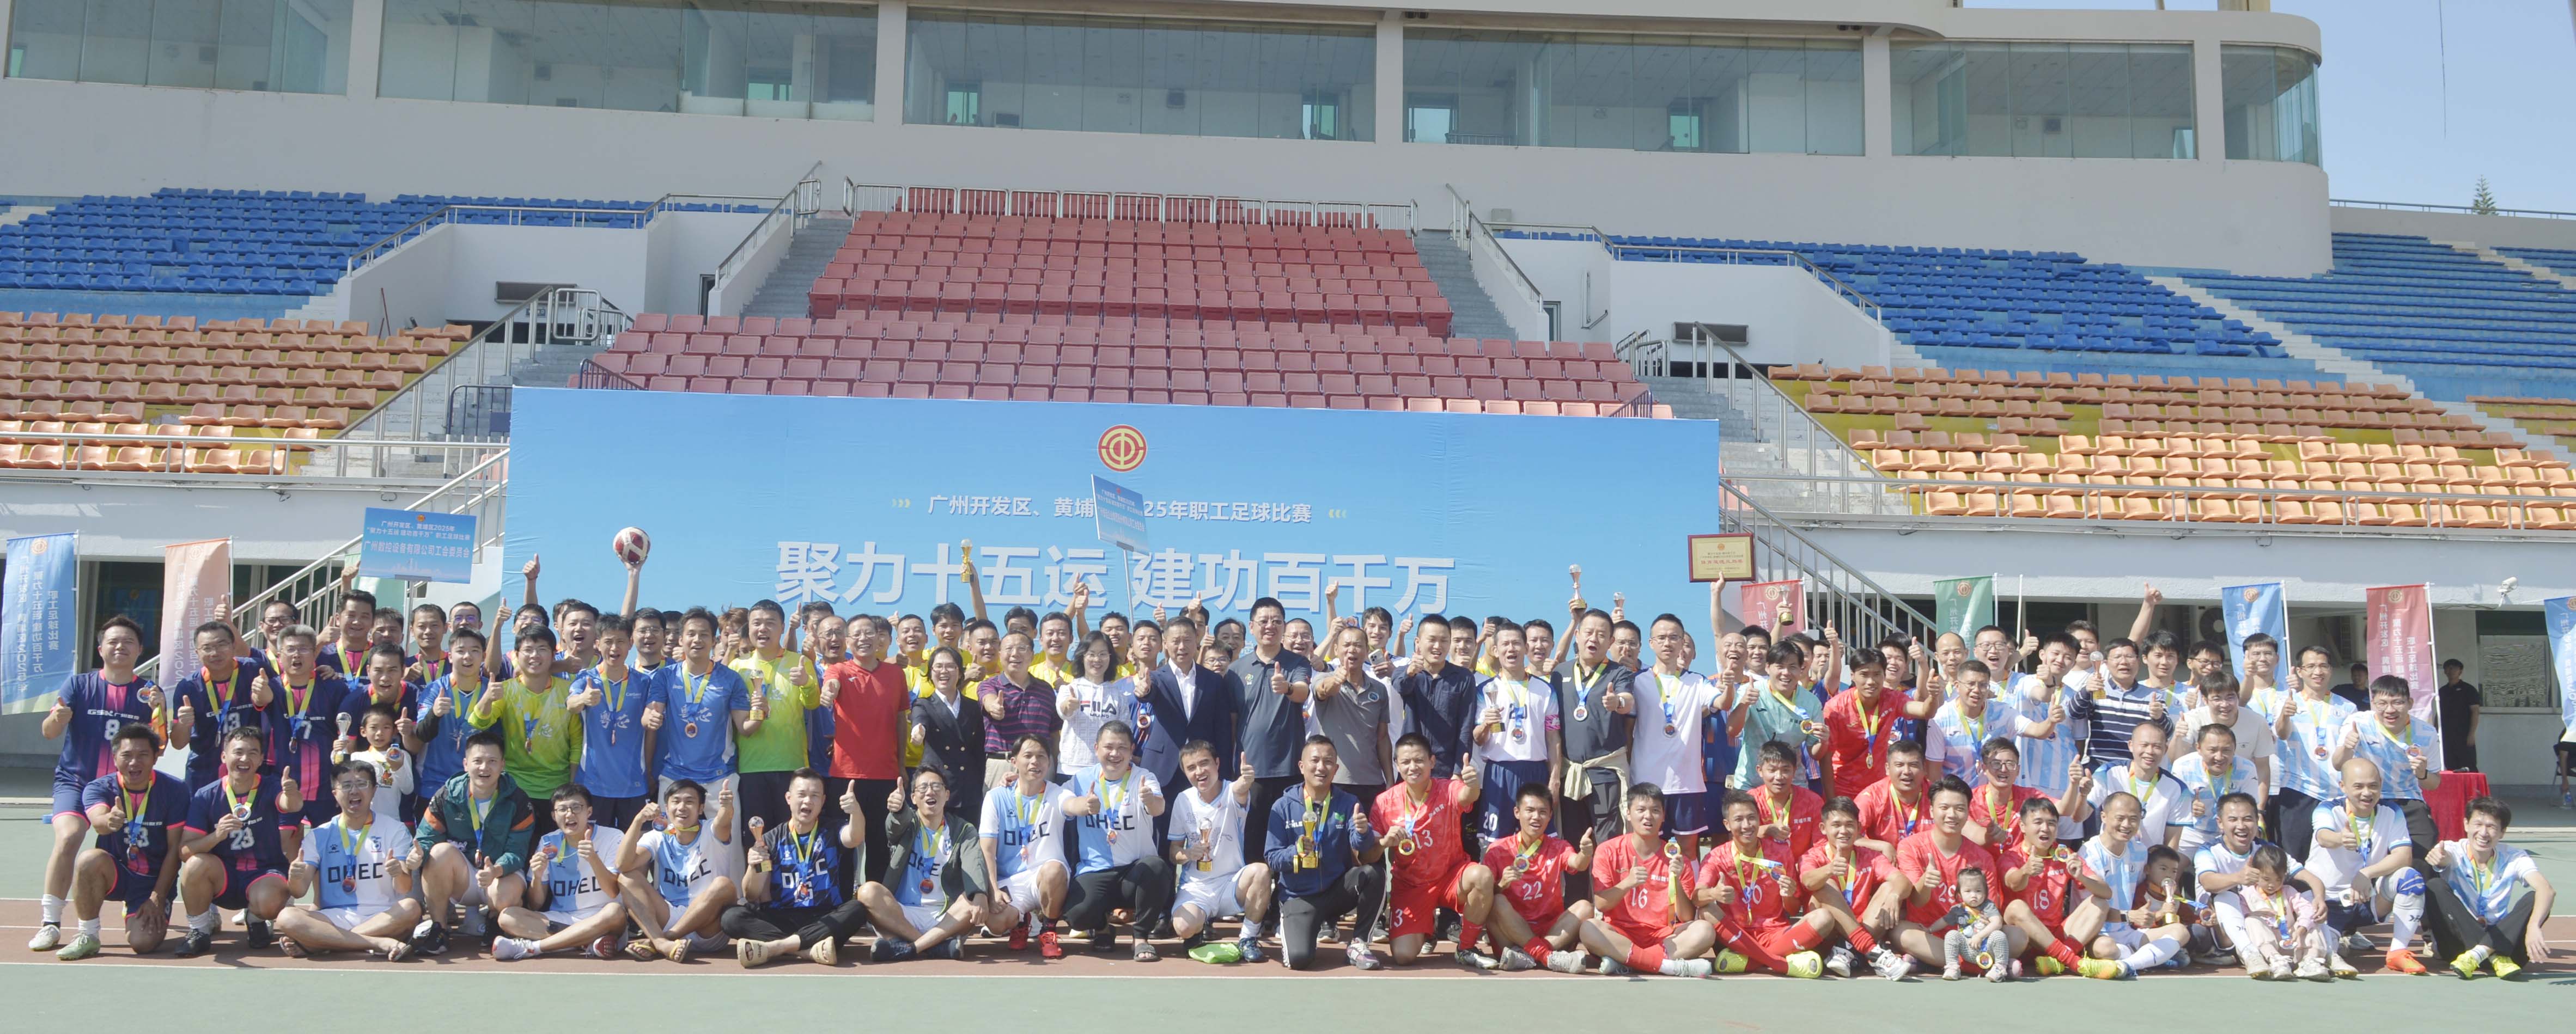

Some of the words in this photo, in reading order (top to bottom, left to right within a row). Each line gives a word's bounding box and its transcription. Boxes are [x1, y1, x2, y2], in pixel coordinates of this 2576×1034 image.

[928, 495, 1311, 523] 广州开发区、黄埔25年职工足球比赛
[775, 541, 1107, 606] 聚力十五运
[1132, 548, 1455, 614] 建功百千万
[1081, 701, 1117, 715] FILA
[105, 719, 120, 741] 8
[1483, 811, 1497, 831] 20
[230, 828, 254, 850] 23
[1412, 830, 1433, 849] 13
[1522, 880, 1543, 901] 22
[1631, 887, 1648, 909] 16
[2033, 890, 2050, 910] 18
